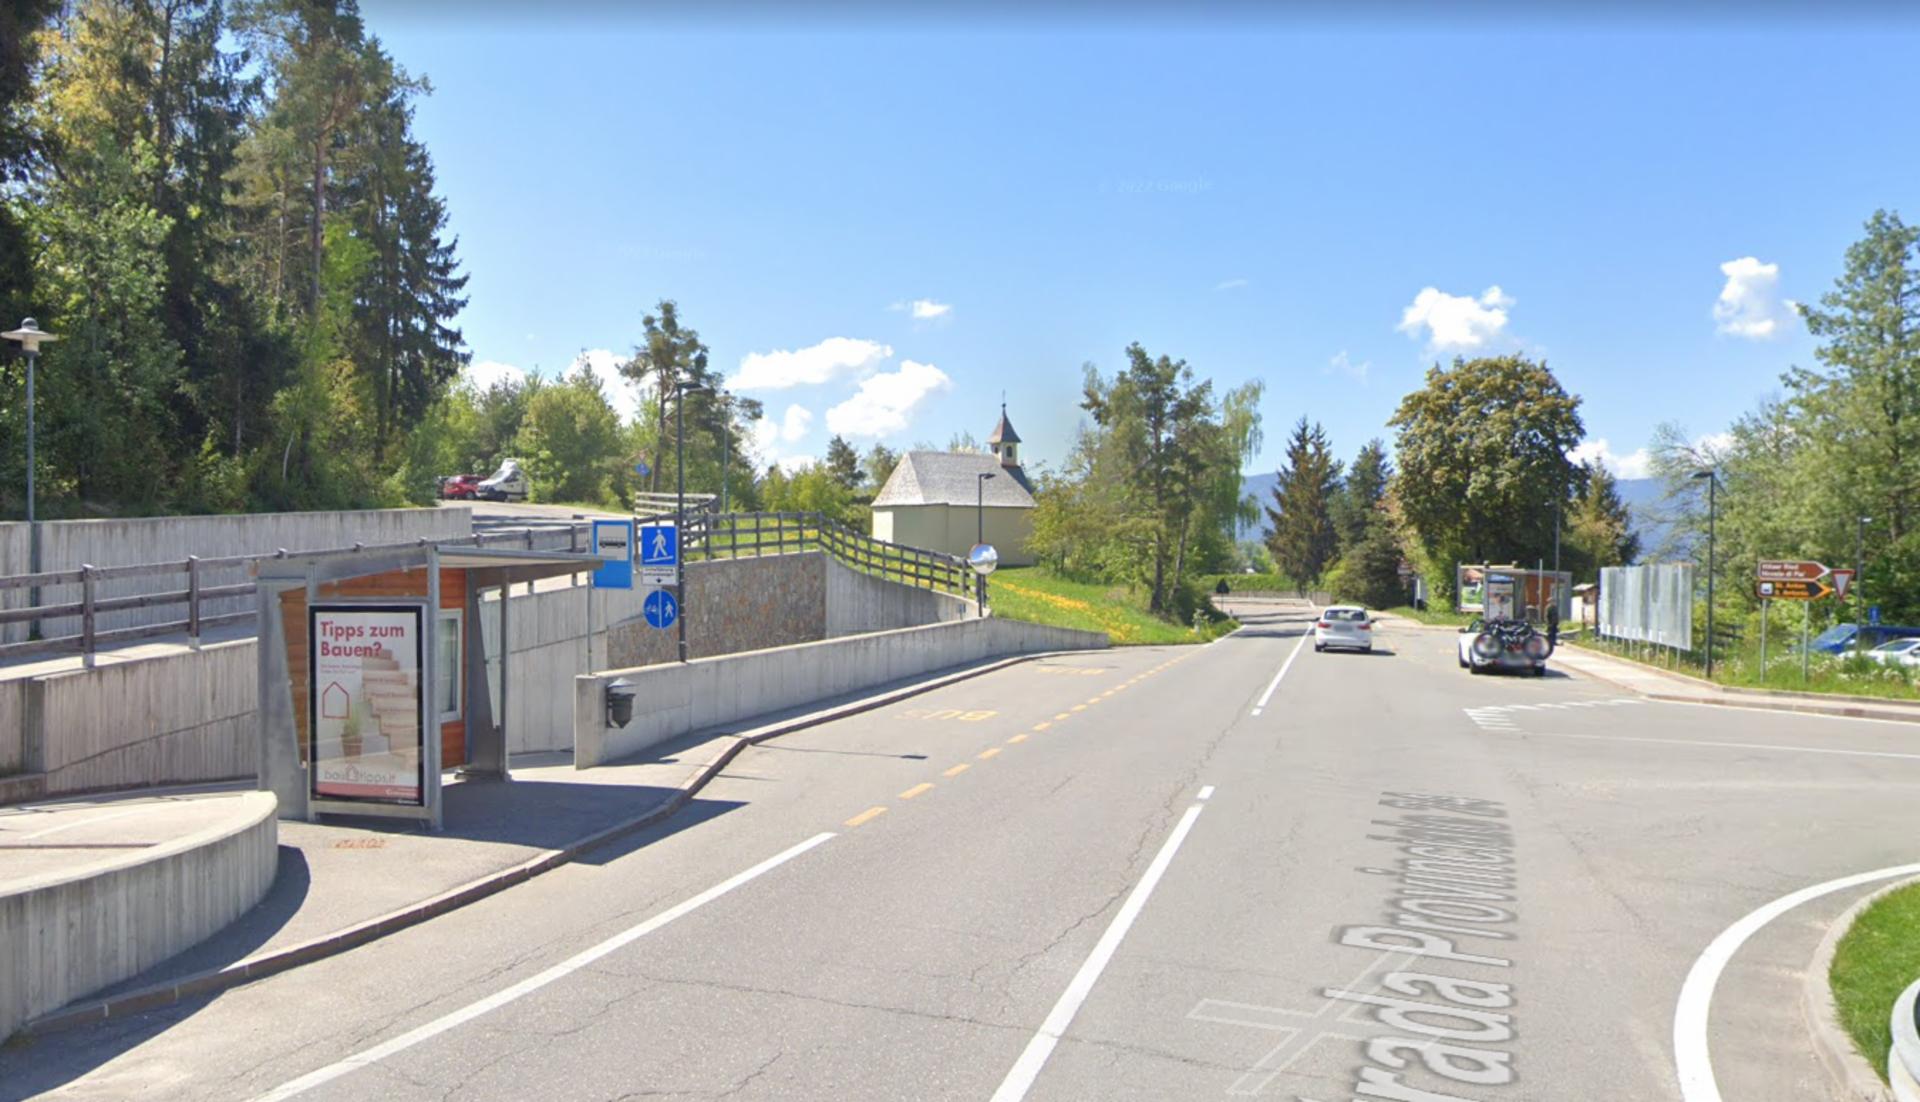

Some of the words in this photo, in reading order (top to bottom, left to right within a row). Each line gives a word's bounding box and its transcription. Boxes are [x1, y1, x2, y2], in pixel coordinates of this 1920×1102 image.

[320, 620, 364, 641] Tipps
[369, 625, 404, 637] zum
[321, 641, 382, 657] Bauen?
